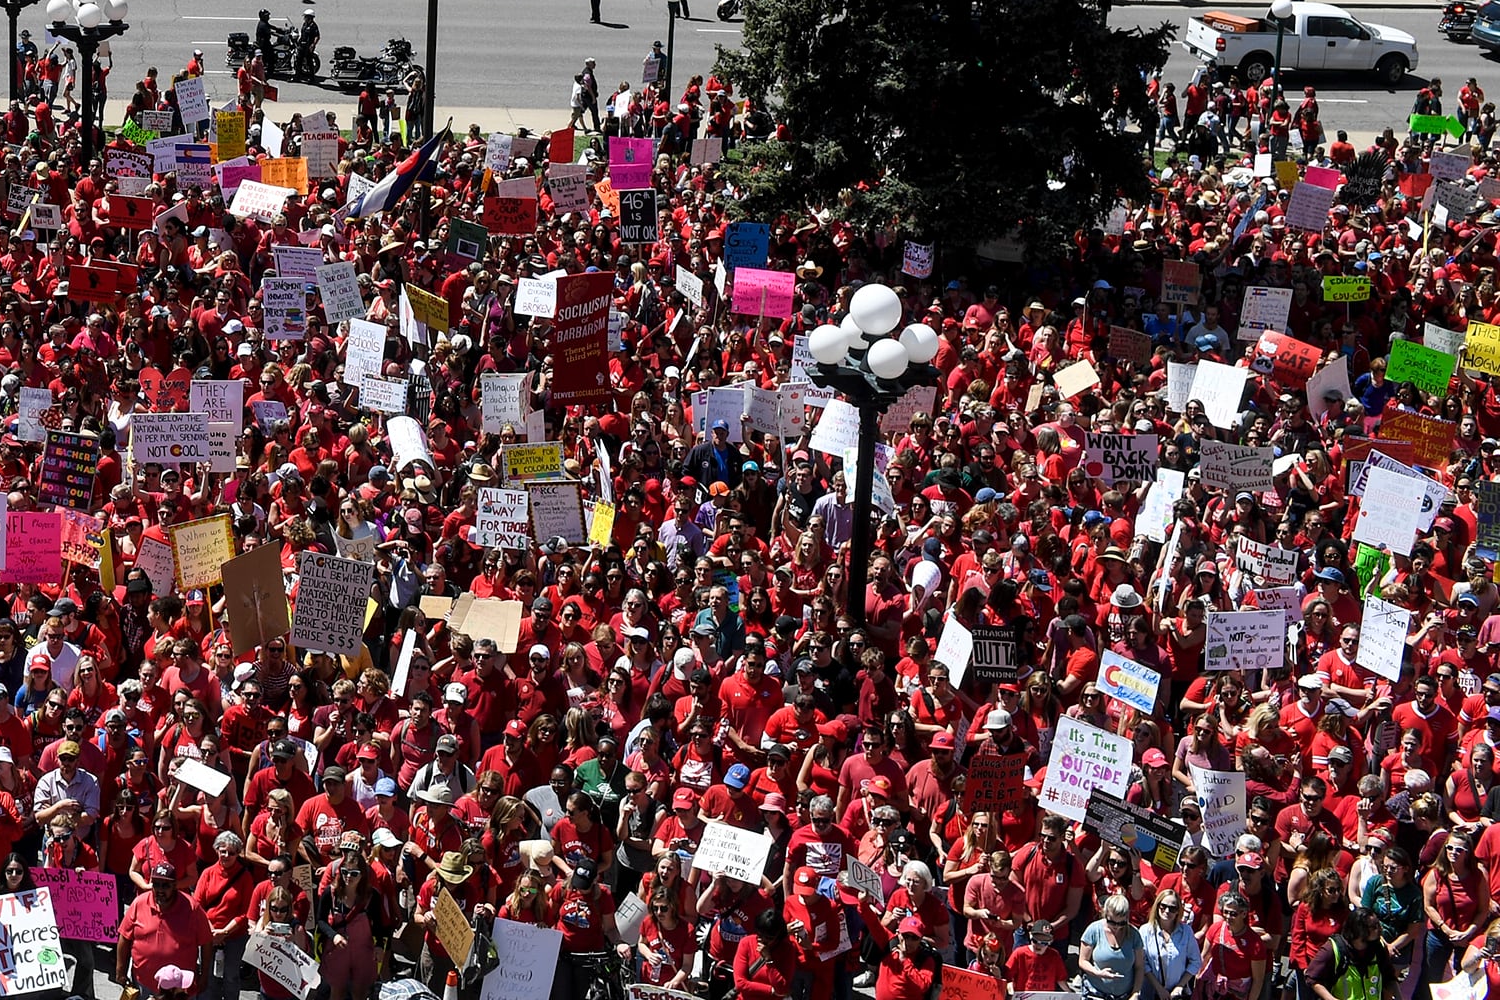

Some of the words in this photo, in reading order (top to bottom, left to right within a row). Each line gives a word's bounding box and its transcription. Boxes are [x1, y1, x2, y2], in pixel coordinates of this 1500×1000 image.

[1212, 21, 1236, 31] RIDGID
[303, 132, 338, 141] TEACHING
[621, 192, 652, 211] 46th
[239, 205, 273, 219] BETTER
[621, 225, 642, 240] NOT
[642, 225, 657, 240] OK
[1330, 275, 1371, 286] EDUCATE
[563, 345, 587, 357] There
[566, 352, 587, 364] third
[198, 384, 229, 398] THEY
[203, 398, 227, 408] ARE
[158, 415, 184, 424] BELOW
[186, 414, 202, 422] THE
[133, 424, 166, 433] NATIONAL
[169, 423, 204, 433] AVERAGE
[1395, 419, 1448, 439] Education
[50, 434, 78, 446] CARE
[145, 434, 158, 443] PER
[179, 433, 209, 442] SPENDING
[50, 446, 97, 461] TEACHERS
[147, 446, 169, 458] NOT
[170, 444, 205, 458] COOL
[509, 449, 537, 459] FUNDING
[542, 448, 554, 456] FOR
[510, 456, 544, 466] EDUCATION
[1103, 450, 1150, 466] BACK
[523, 464, 561, 474] COLORADO
[1111, 464, 1159, 482] DOWN
[64, 487, 90, 499] YOUR
[481, 489, 502, 503] ALL
[505, 493, 525, 505] THE
[50, 495, 76, 507] KIDS
[491, 506, 516, 518] WAY
[480, 520, 500, 531] FOR
[494, 533, 517, 546] PAY
[304, 555, 316, 565] A
[317, 557, 352, 573] GREAT
[353, 562, 372, 576] DAY
[303, 566, 327, 580] WILL
[300, 577, 349, 595] EDUCATION
[353, 587, 365, 597] IS
[297, 597, 315, 608] AND
[296, 606, 315, 618] HAS
[315, 608, 328, 620] TO
[330, 611, 360, 626] HAVE
[295, 615, 321, 629] BAKE
[322, 620, 350, 635] SALES
[350, 626, 363, 638] TO
[294, 629, 324, 643] RAISE
[971, 629, 1016, 640] STRAIGHT
[1228, 632, 1247, 643] NOT
[974, 641, 1016, 667] OUTTA
[976, 670, 1018, 680] FUNDING
[1102, 755, 1119, 767] our
[1061, 753, 1123, 786] OUTSIDE
[975, 789, 1018, 801] DEBT
[255, 943, 284, 966] You're
